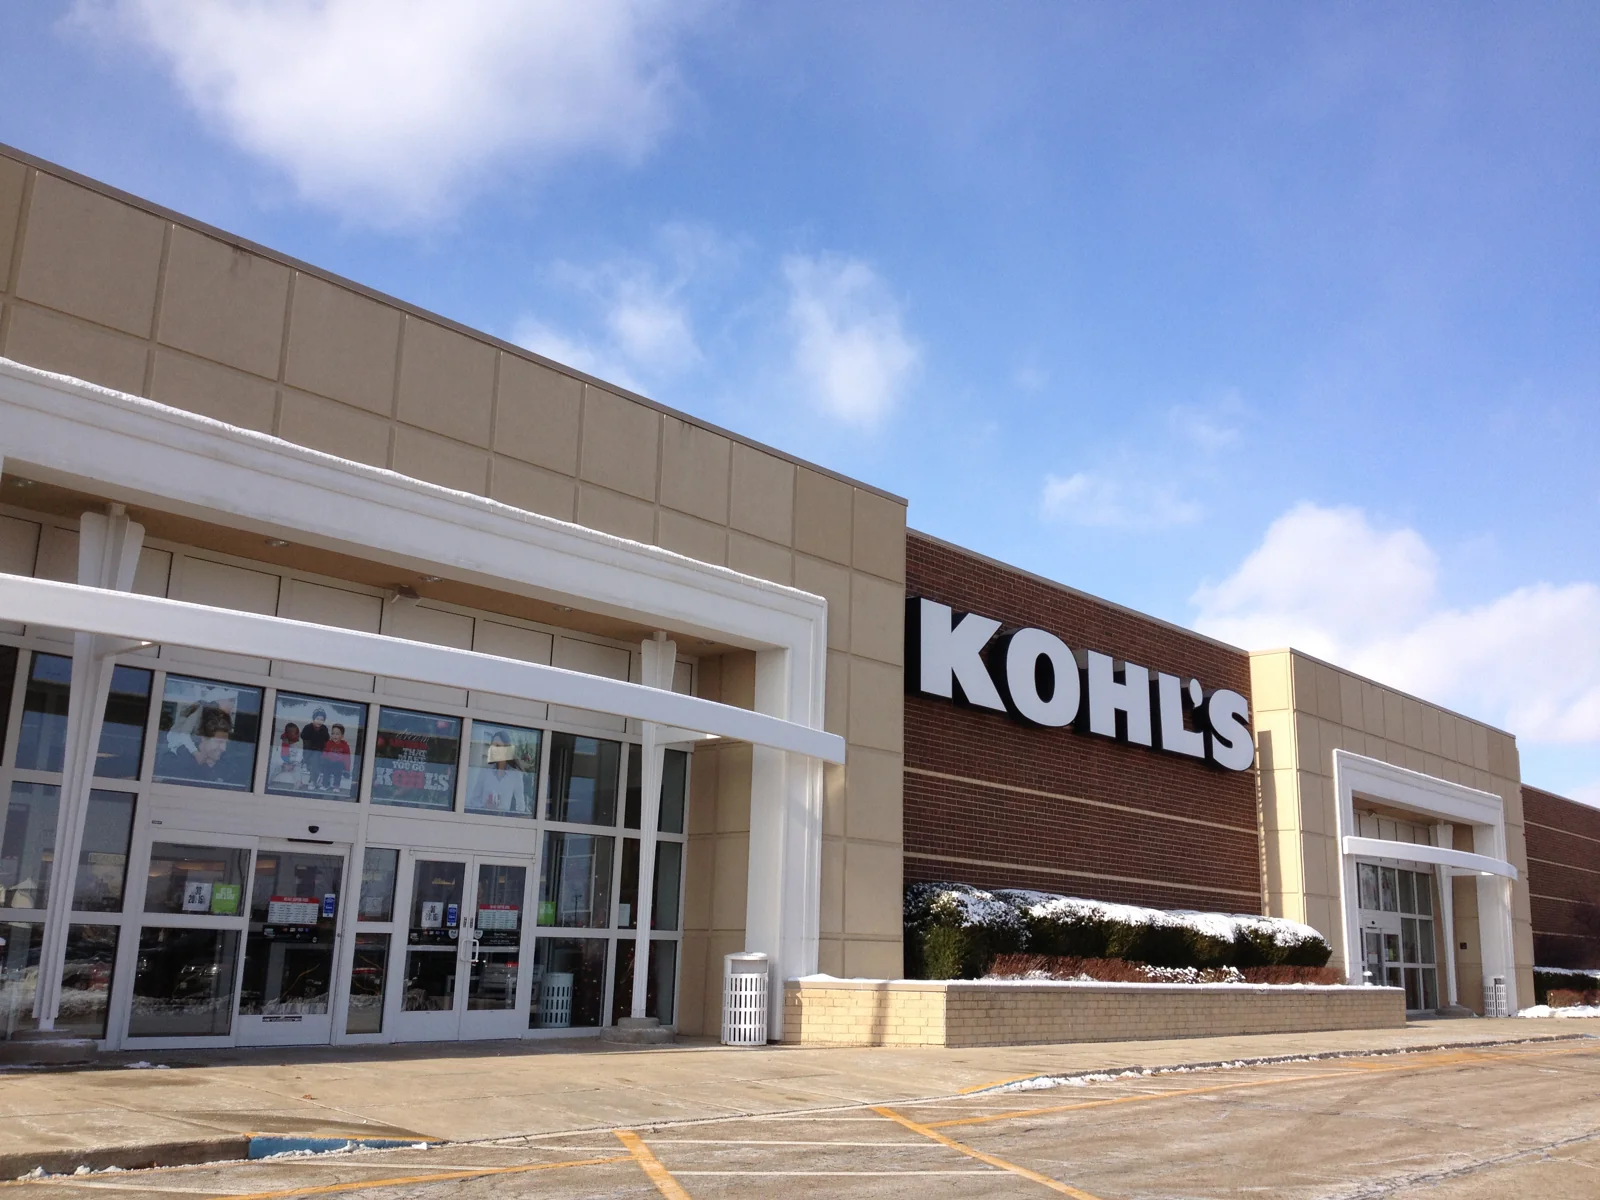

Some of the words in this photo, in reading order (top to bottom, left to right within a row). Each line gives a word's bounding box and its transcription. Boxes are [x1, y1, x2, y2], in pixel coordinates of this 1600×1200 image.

[919, 597, 1255, 772] KOHL'S
[403, 748, 426, 757] THAT
[398, 754, 426, 764] MAKE
[392, 761, 410, 770] YOU
[412, 763, 424, 772] GO
[375, 767, 449, 791] KOHL'S
